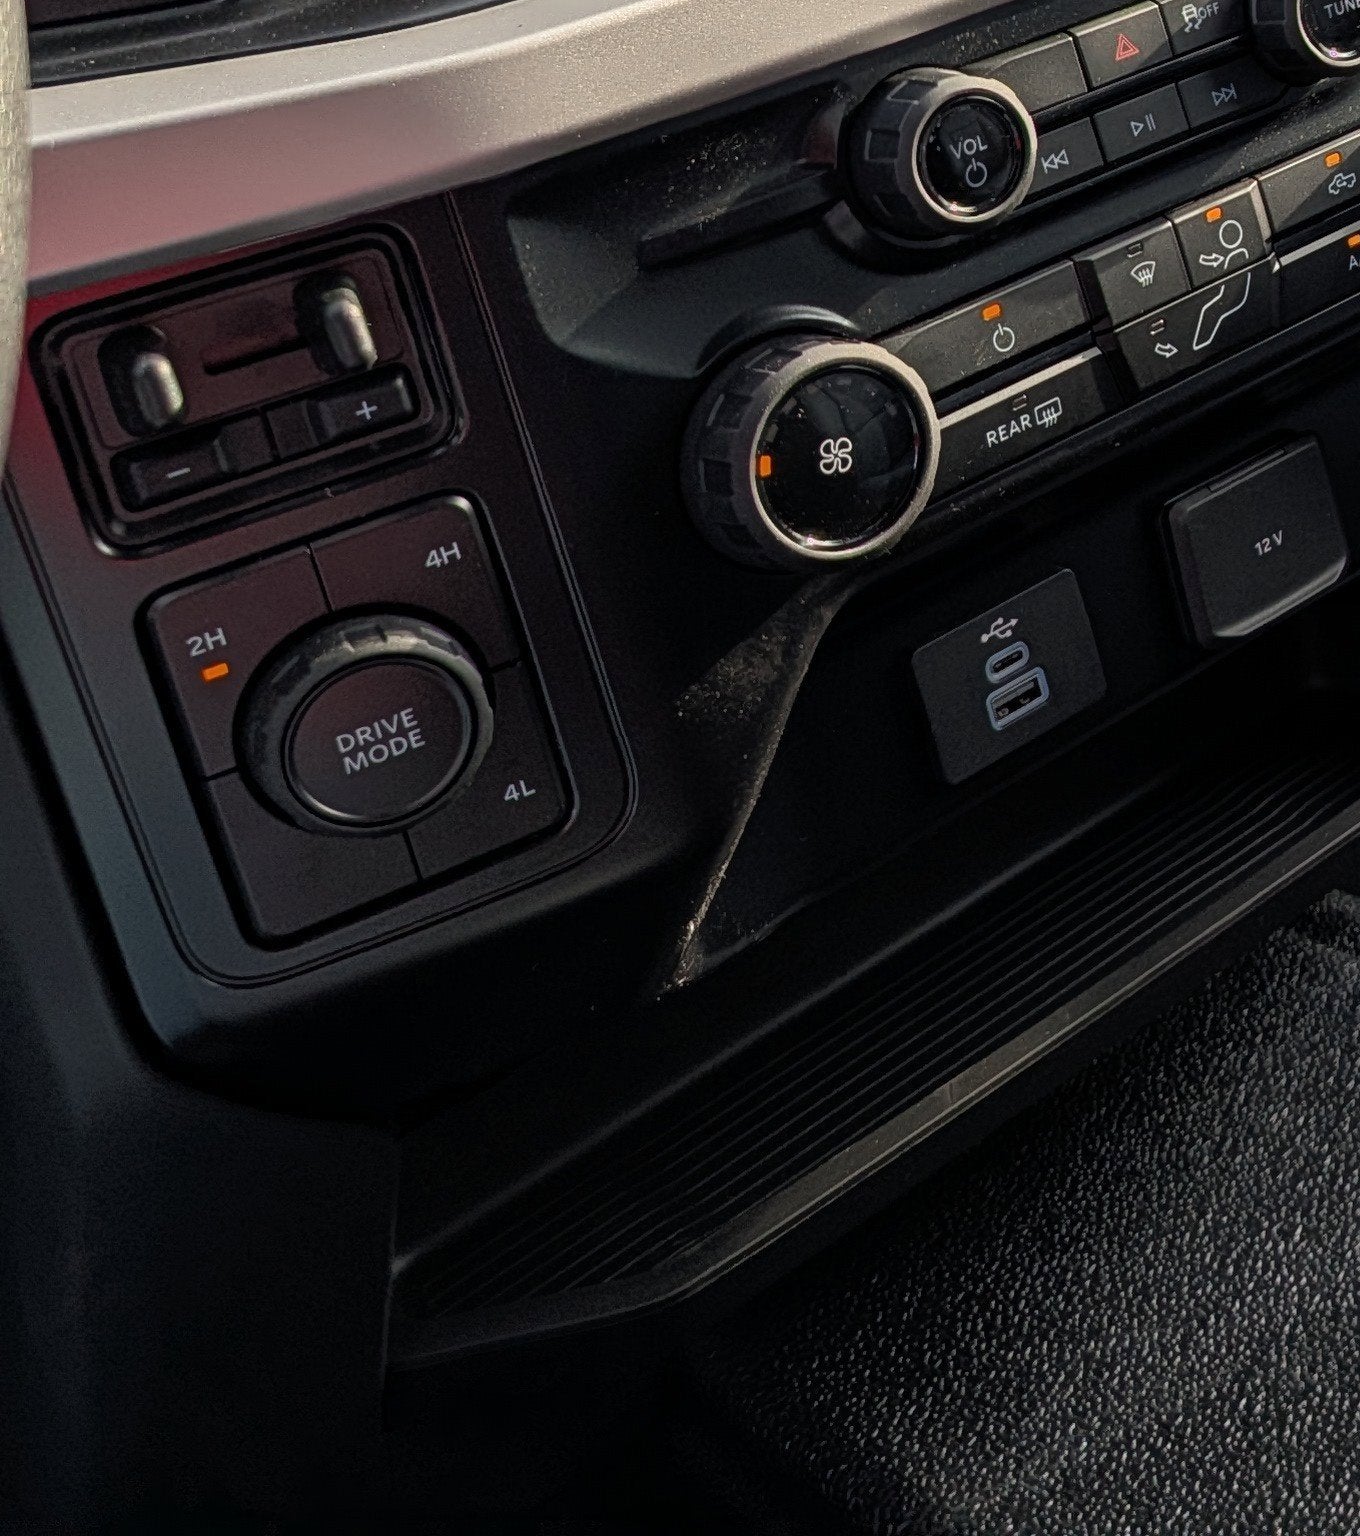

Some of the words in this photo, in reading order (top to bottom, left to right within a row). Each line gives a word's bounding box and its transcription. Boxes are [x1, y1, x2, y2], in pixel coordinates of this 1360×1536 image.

[1197, 1, 1221, 20] OFF
[948, 134, 988, 160] VOL
[986, 413, 1033, 448] REAR
[424, 541, 462, 568] 4H
[185, 626, 229, 658] 2H
[335, 707, 419, 755] DRIVE
[341, 728, 426, 776] MODE
[503, 779, 537, 803] 4L
